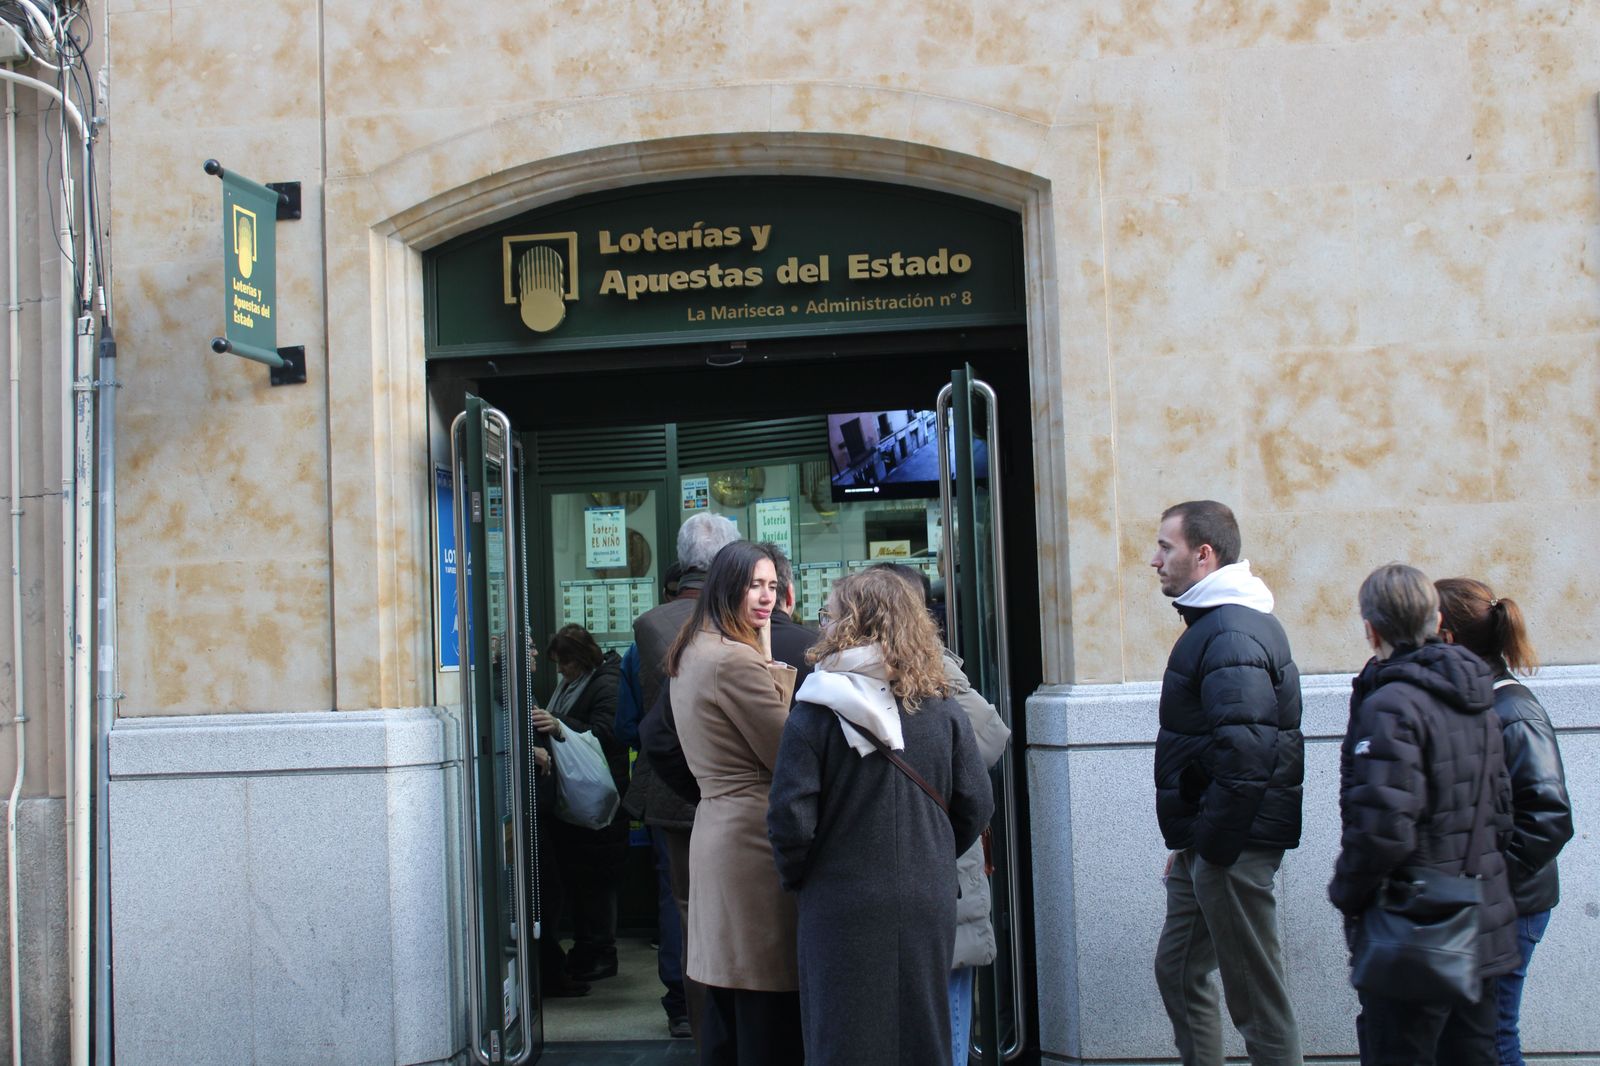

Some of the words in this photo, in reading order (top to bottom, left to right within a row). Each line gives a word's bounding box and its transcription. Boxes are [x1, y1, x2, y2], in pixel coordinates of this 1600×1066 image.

[599, 221, 742, 254] Loterías
[750, 225, 772, 251] y
[600, 263, 764, 300] Apuestas
[776, 255, 830, 284] del
[848, 248, 972, 279] Estado
[233, 277, 257, 298] Loterías
[257, 289, 262, 303] y
[234, 294, 260, 315] Apuestas
[261, 304, 270, 319] del
[687, 306, 706, 322] La
[711, 303, 785, 321] Mariseca
[805, 292, 934, 315] Administración
[961, 290, 973, 306] 8
[234, 310, 254, 329] Estado
[762, 531, 788, 542] Navidad
